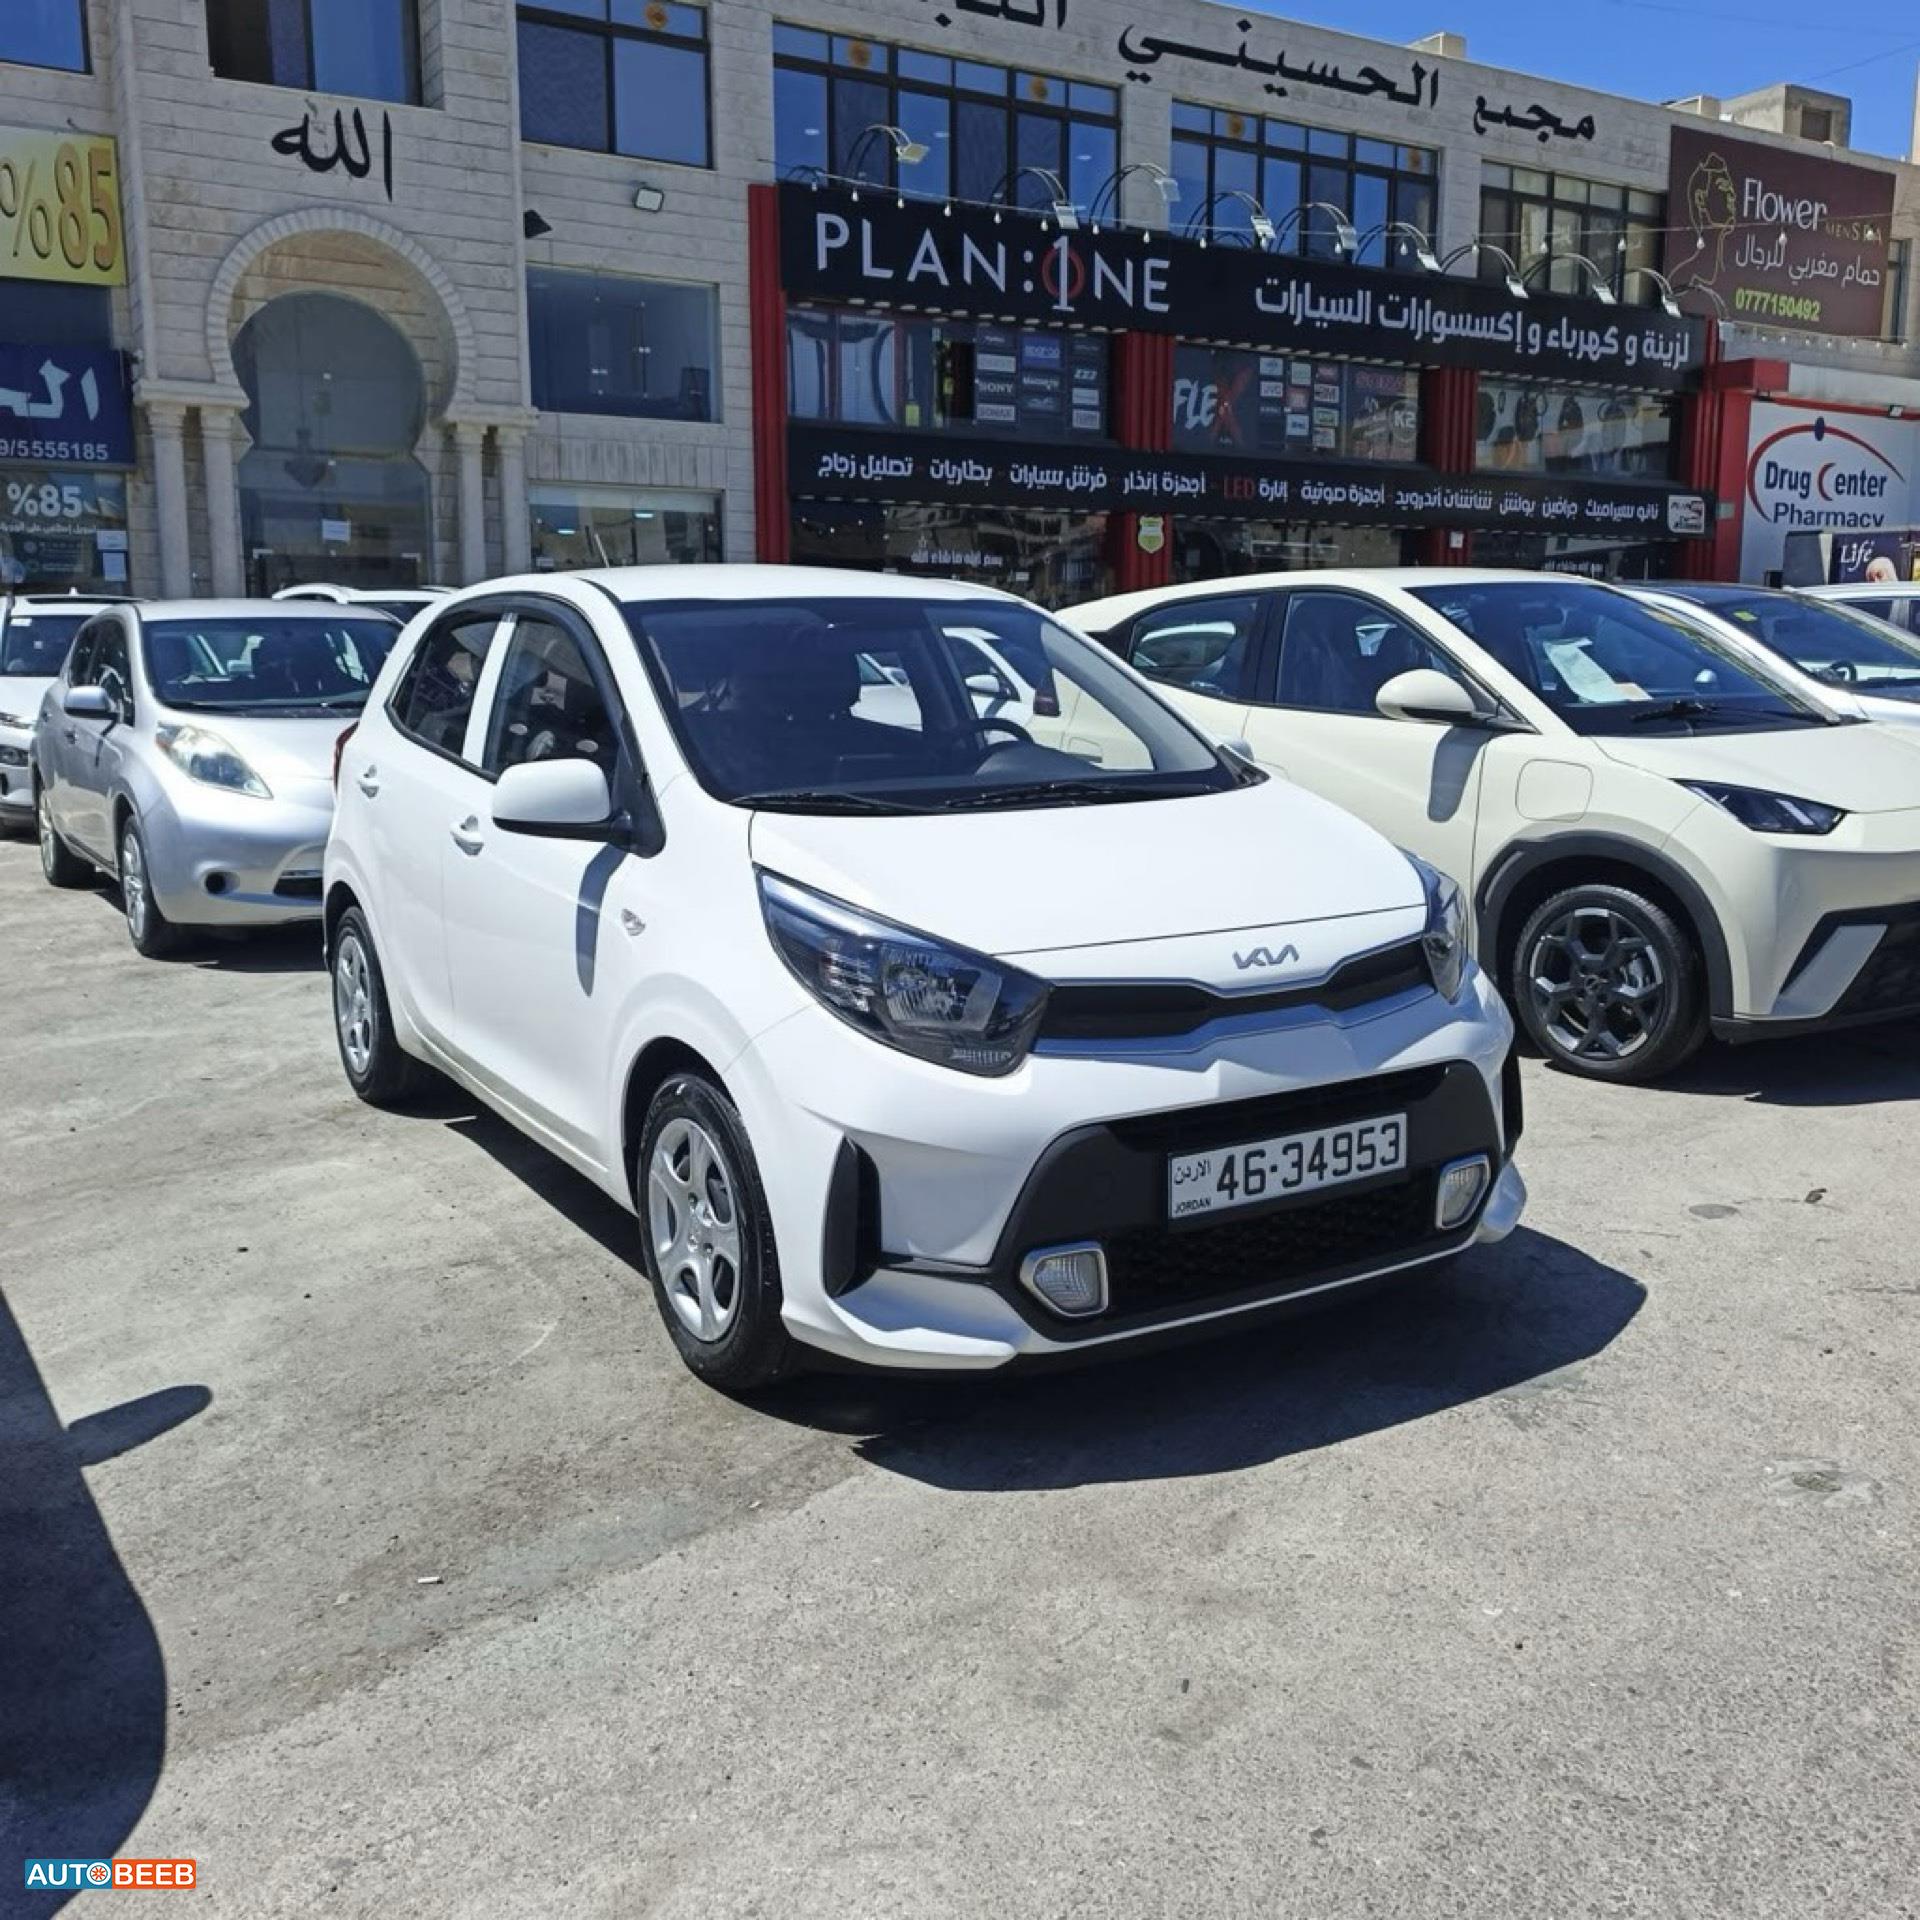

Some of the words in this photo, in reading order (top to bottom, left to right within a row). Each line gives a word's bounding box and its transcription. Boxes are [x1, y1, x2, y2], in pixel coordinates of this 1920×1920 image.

[1118, 19, 1439, 109] الحسيني
[1474, 96, 1595, 141] مجمع
[272, 99, 393, 203] الله
[1743, 177, 1827, 231] Flower
[1736, 232, 1787, 271] للرجال
[1788, 252, 1838, 286] مغربي
[1841, 255, 1880, 288] حمام
[1255, 278, 1372, 328] السيارات
[1378, 294, 1523, 353] إكسسوارات
[1528, 322, 1541, 354] و
[1547, 316, 1618, 361] كهرباء
[1625, 334, 1637, 366] و
[930, 458, 992, 486] بطاريات
[1010, 463, 1064, 489] سيارات
[1764, 461, 1812, 499] Drug
[1817, 462, 1888, 501] Center
[1232, 944, 1299, 970] KIA
[1174, 1197, 1212, 1214] JORDAN
